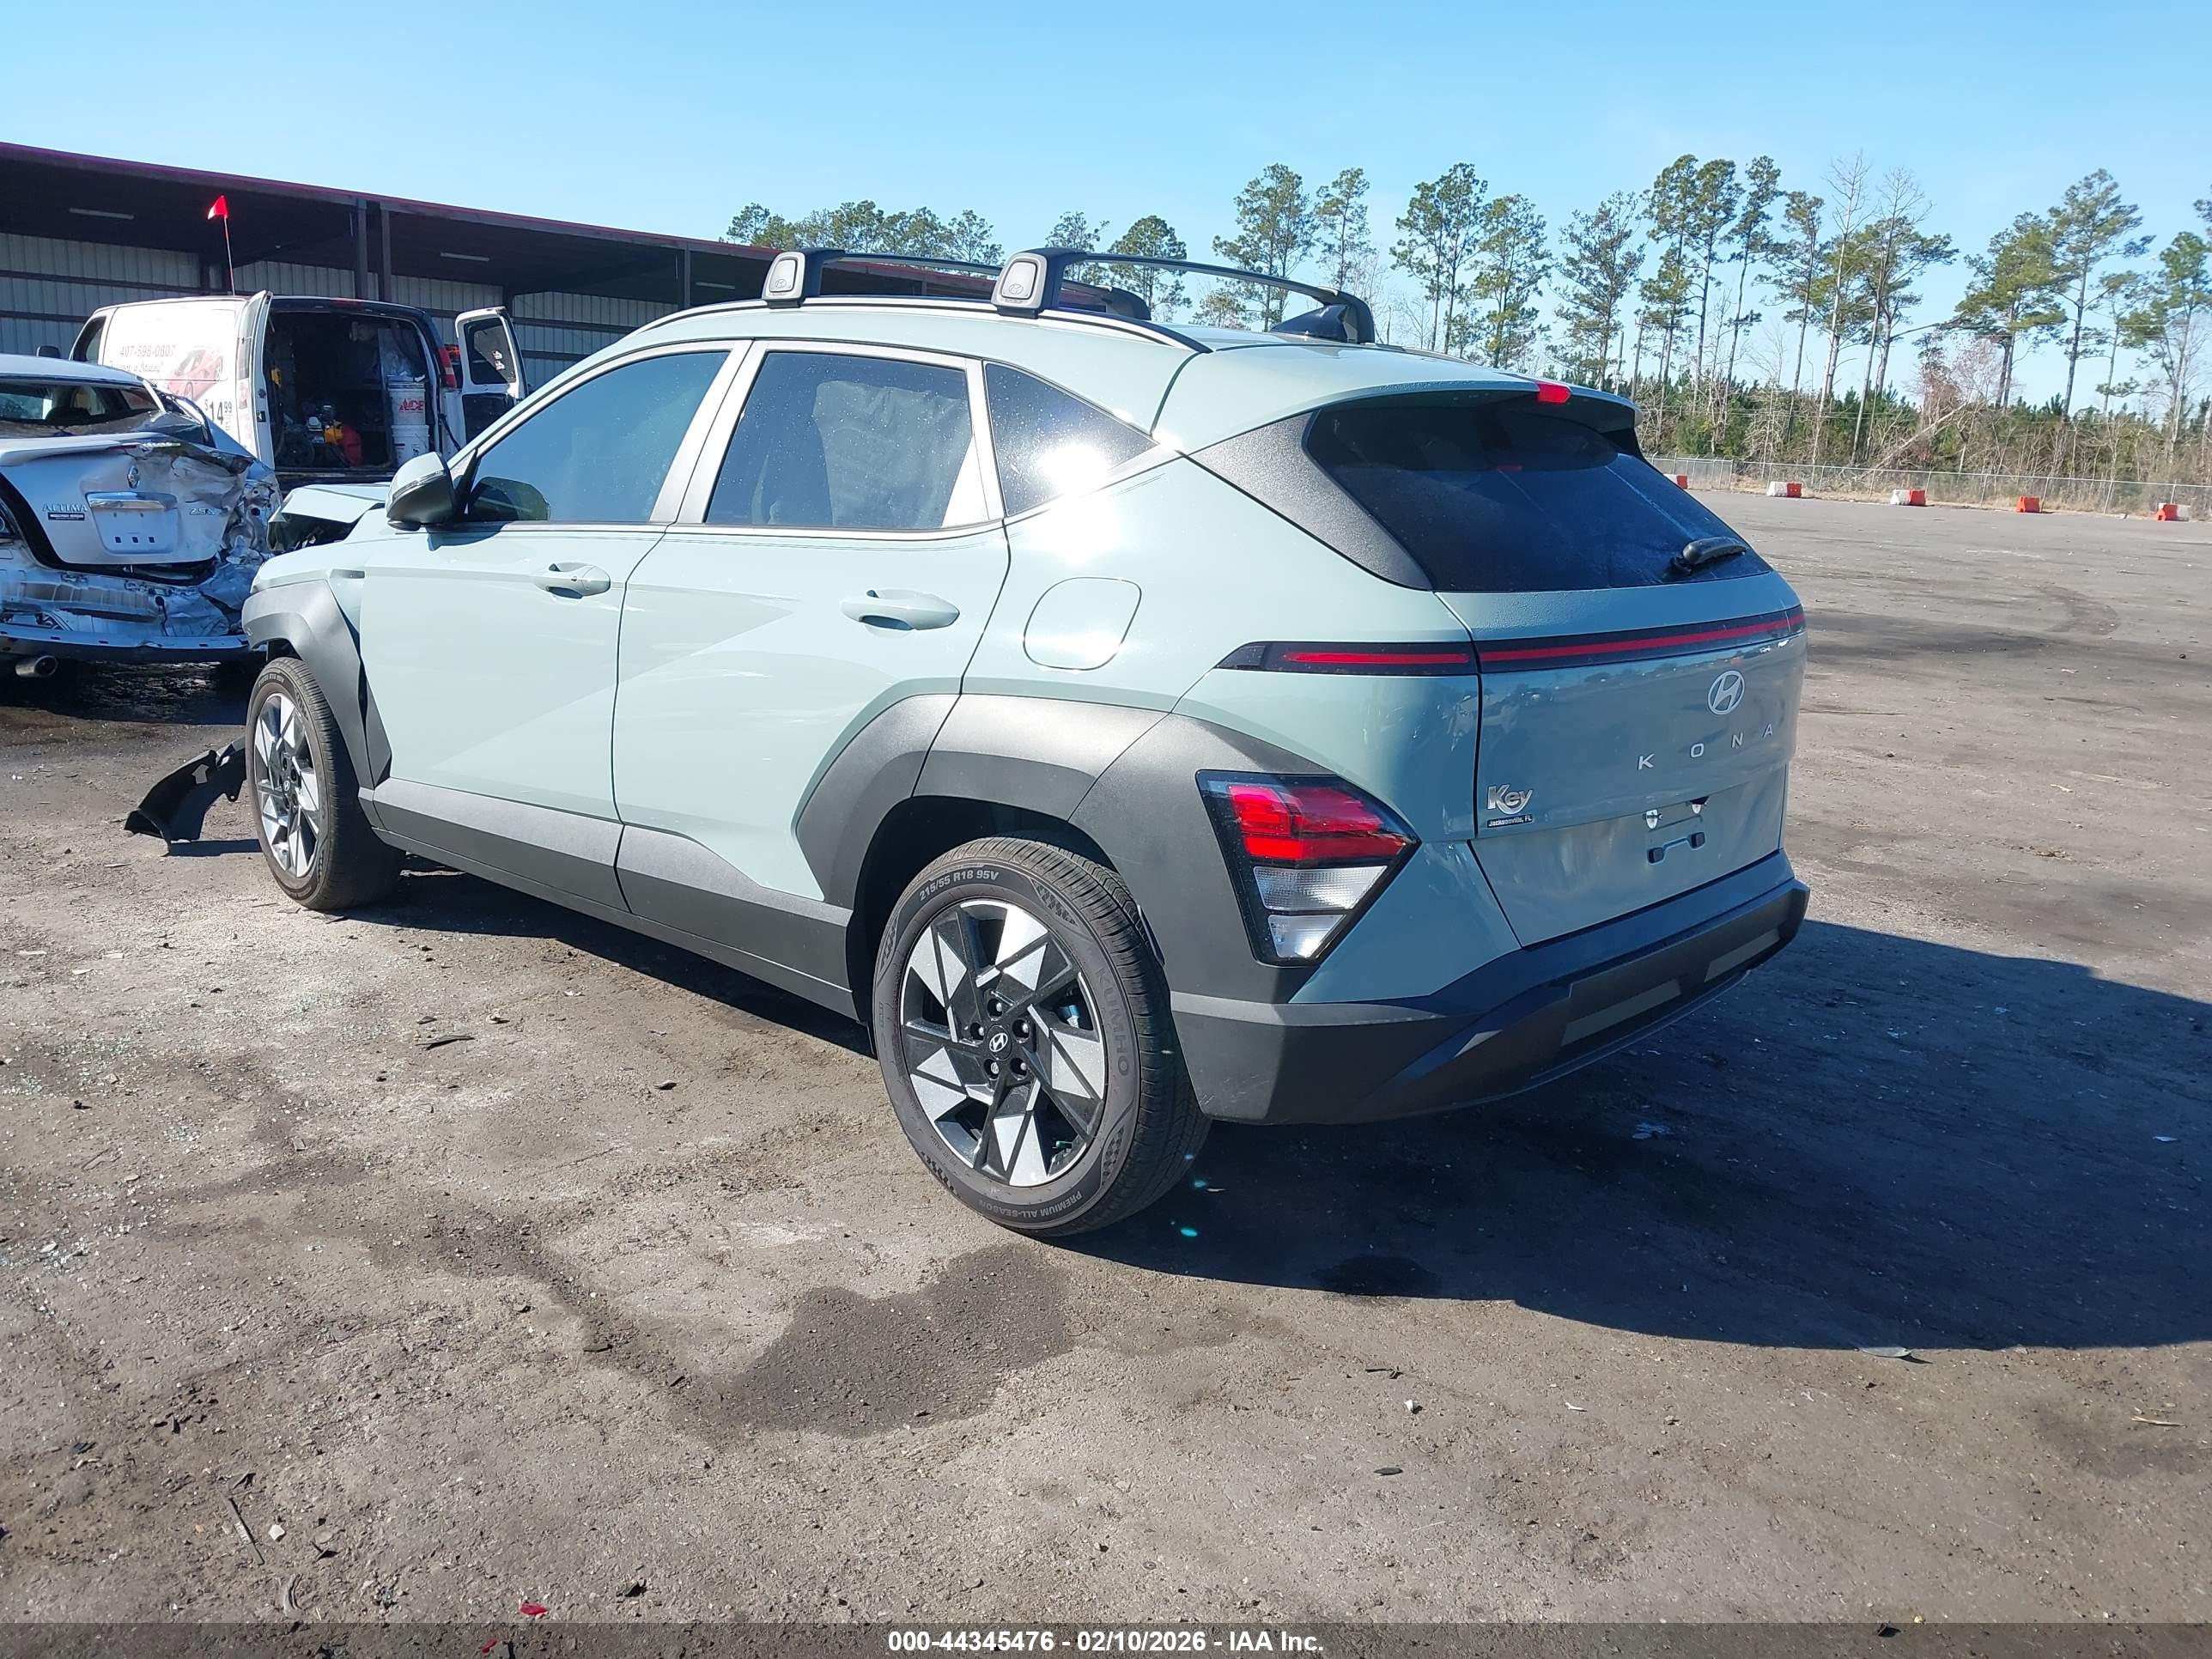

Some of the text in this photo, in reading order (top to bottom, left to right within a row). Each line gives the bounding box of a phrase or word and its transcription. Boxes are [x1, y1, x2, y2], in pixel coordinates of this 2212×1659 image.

[398, 398, 426, 411] ACE
[42, 502, 88, 513] ALTIMA
[1638, 723, 1774, 770] KONA
[1486, 783, 1534, 815] Key
[920, 870, 1000, 902] 215/55 R18 95V
[1040, 1190, 1083, 1214] PREMIUM
